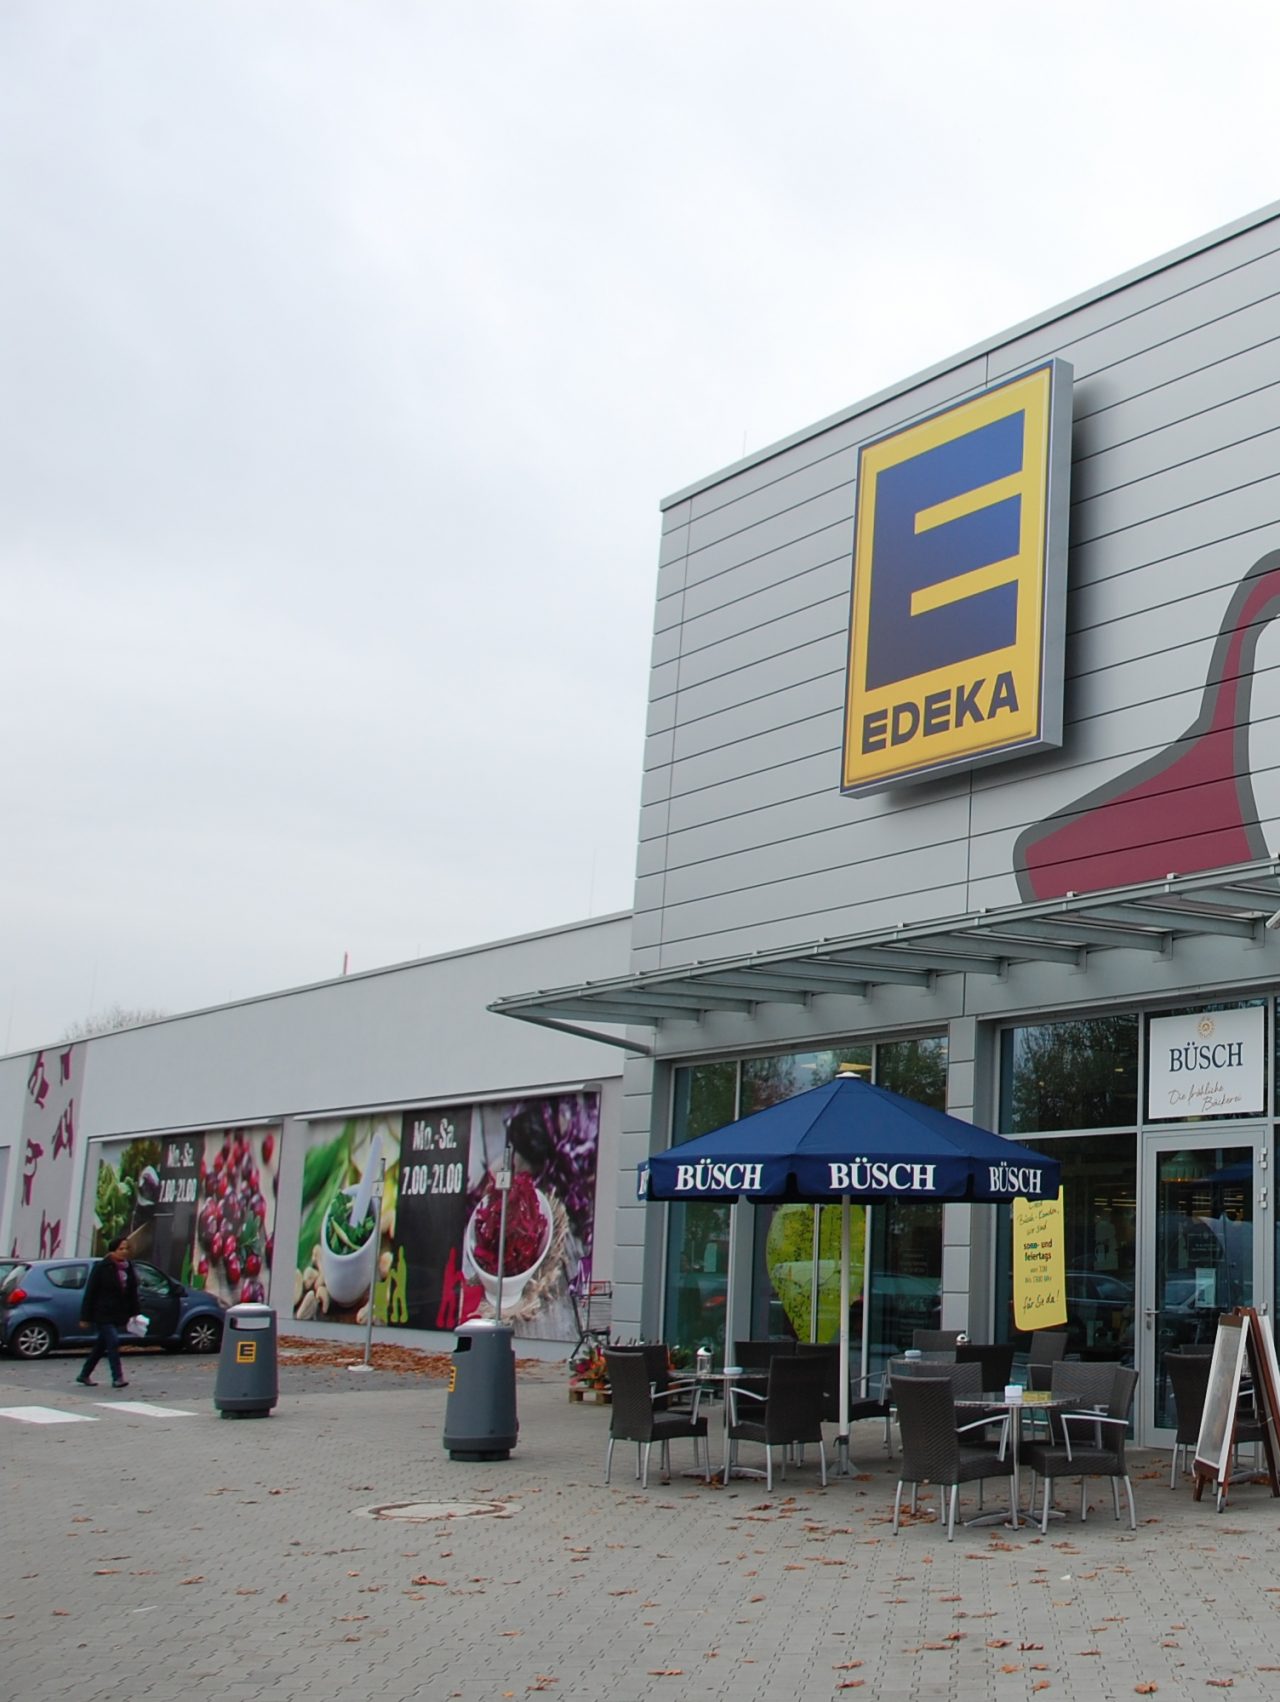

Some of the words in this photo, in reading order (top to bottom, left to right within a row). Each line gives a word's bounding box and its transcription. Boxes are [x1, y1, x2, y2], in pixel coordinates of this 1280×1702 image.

[865, 408, 1026, 693] E
[861, 670, 1019, 755] EDEKA
[1168, 1041, 1244, 1072] BÜSCH
[412, 1118, 457, 1151] Mo.-Sa.
[401, 1162, 463, 1195] 7.00-21.00
[674, 1158, 764, 1191] BÜSCH
[828, 1157, 937, 1191] BÜSCH
[988, 1161, 1042, 1194] BÜSCH
